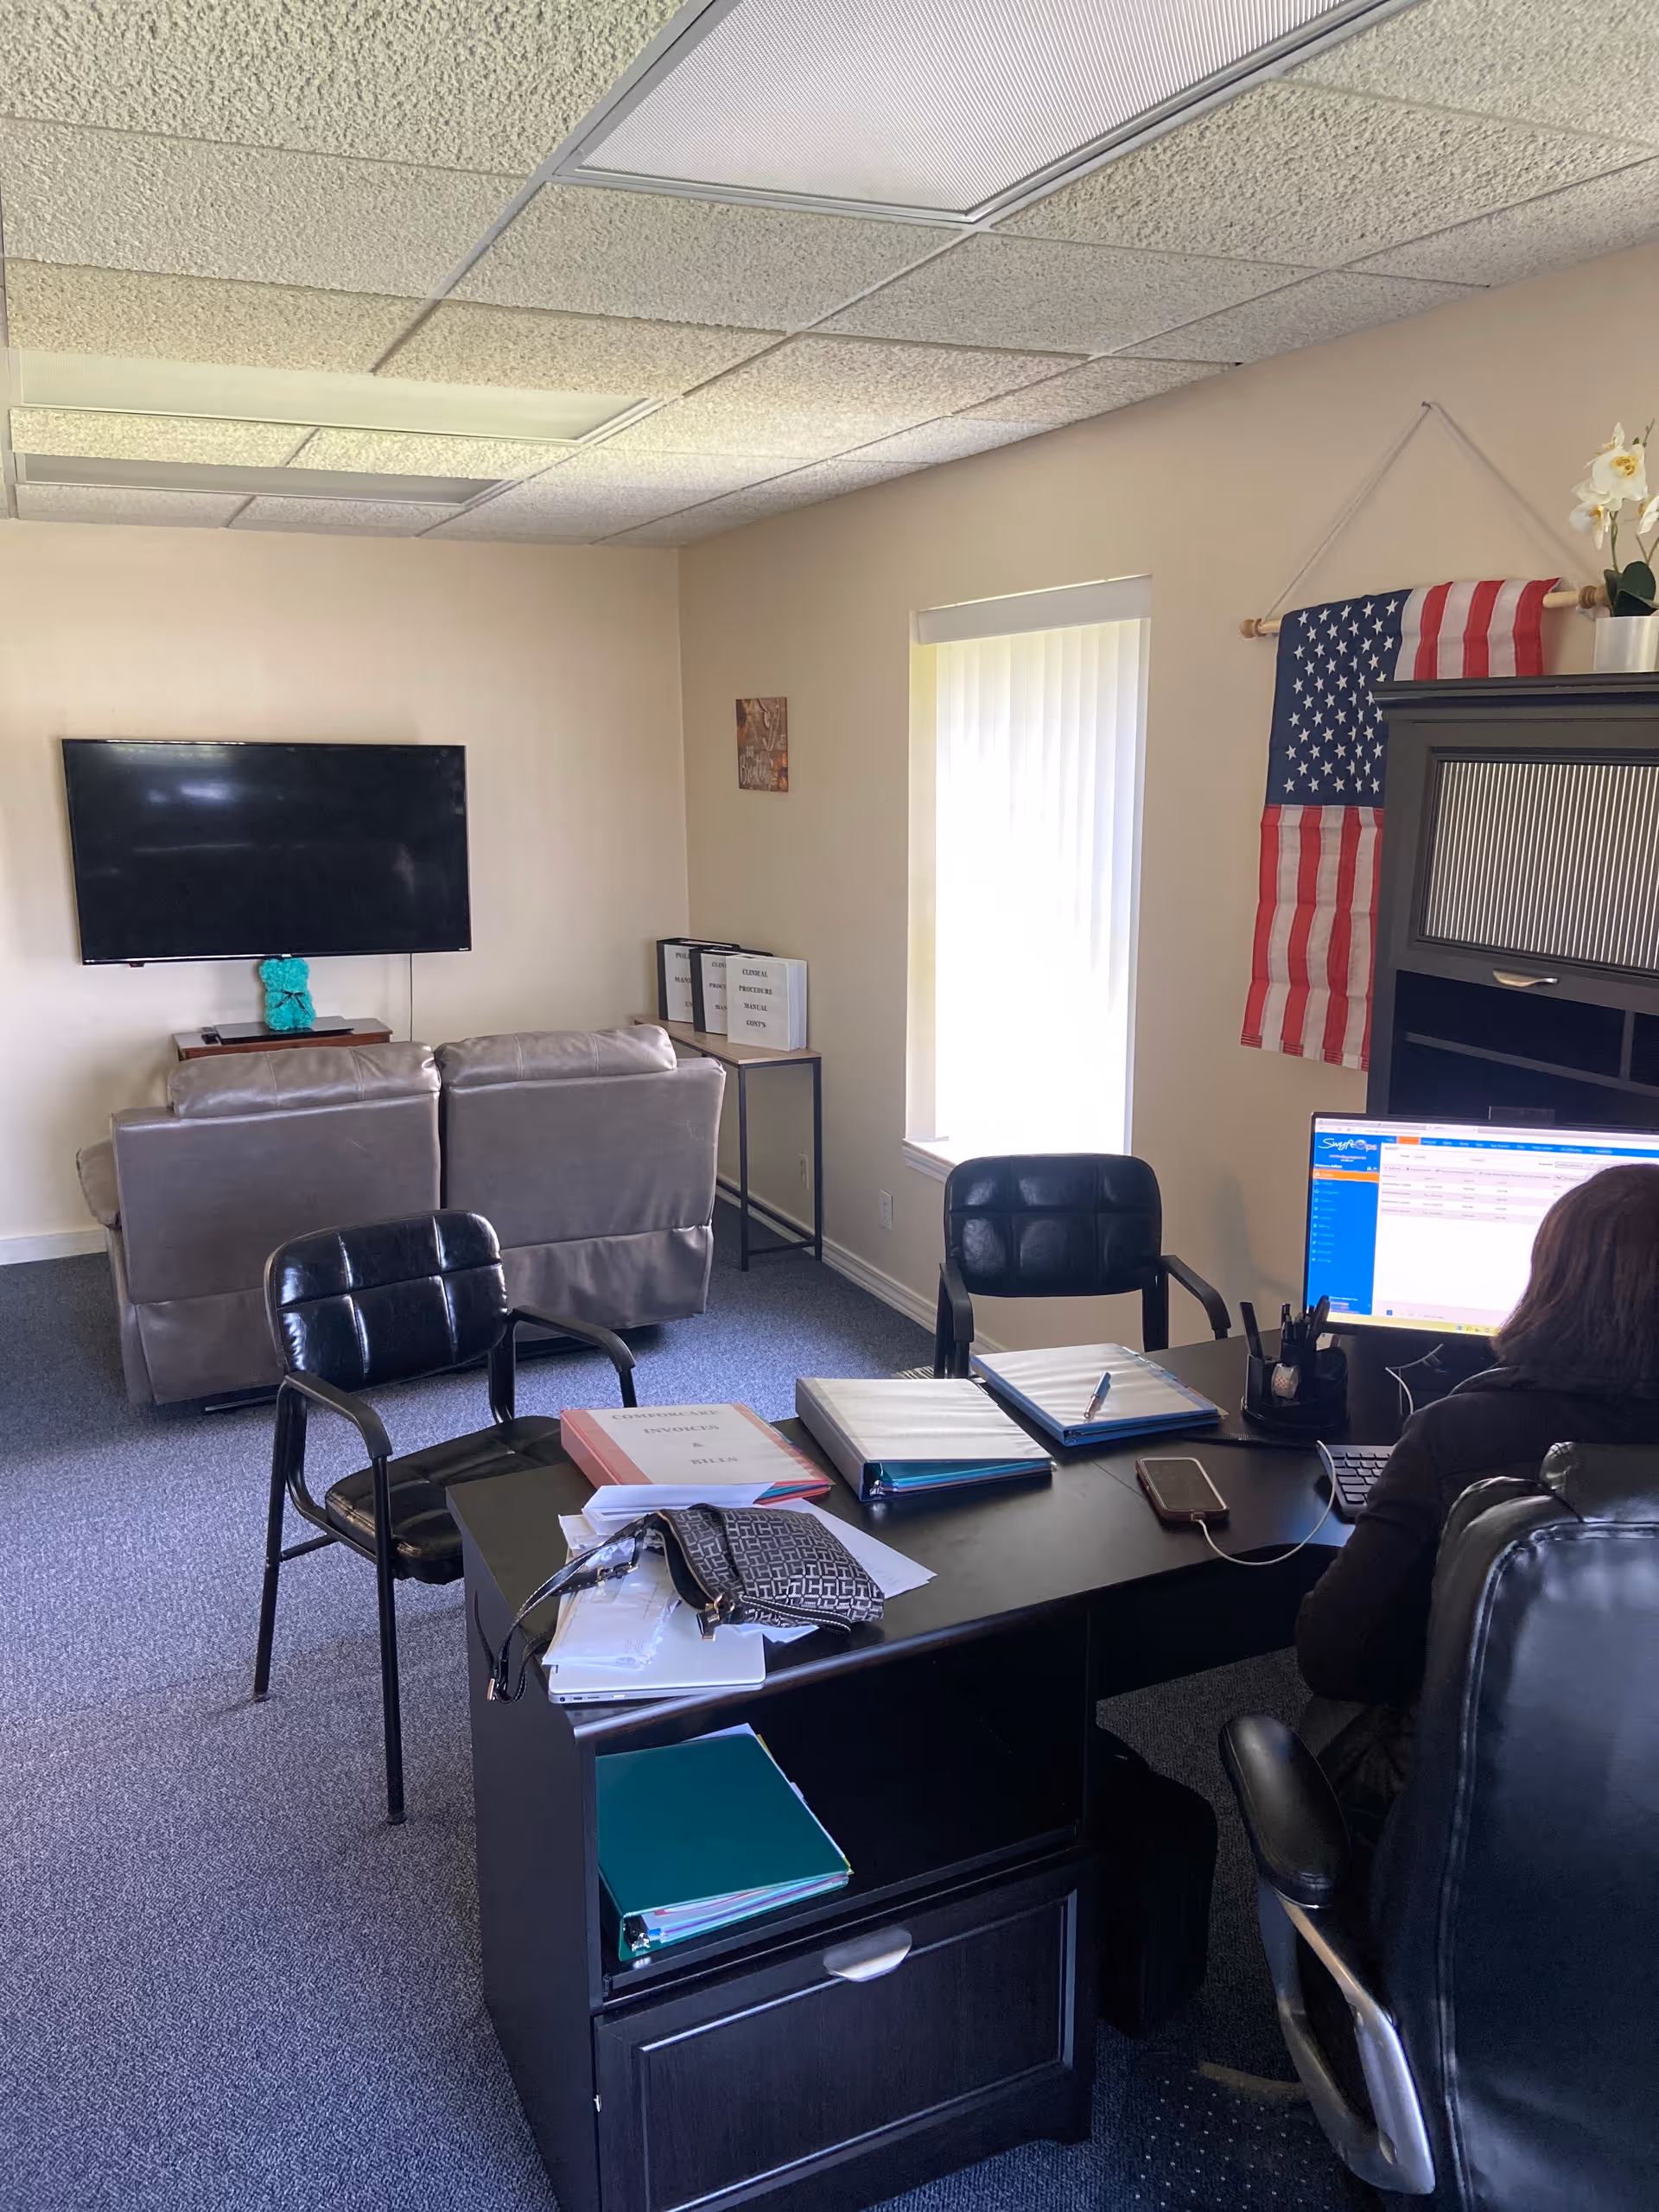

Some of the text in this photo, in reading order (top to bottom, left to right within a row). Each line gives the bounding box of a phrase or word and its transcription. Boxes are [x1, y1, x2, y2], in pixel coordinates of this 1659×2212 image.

[742, 969, 768, 978] CLINICAL
[738, 985, 773, 995] PROCEDURE
[743, 1002, 768, 1012] MANUAL
[1318, 1137, 1377, 1152] SwyftOps
[612, 1410, 719, 1420] COMFORCARE
[643, 1424, 720, 1434] INVOICES
[690, 1456, 739, 1465] BILLS
